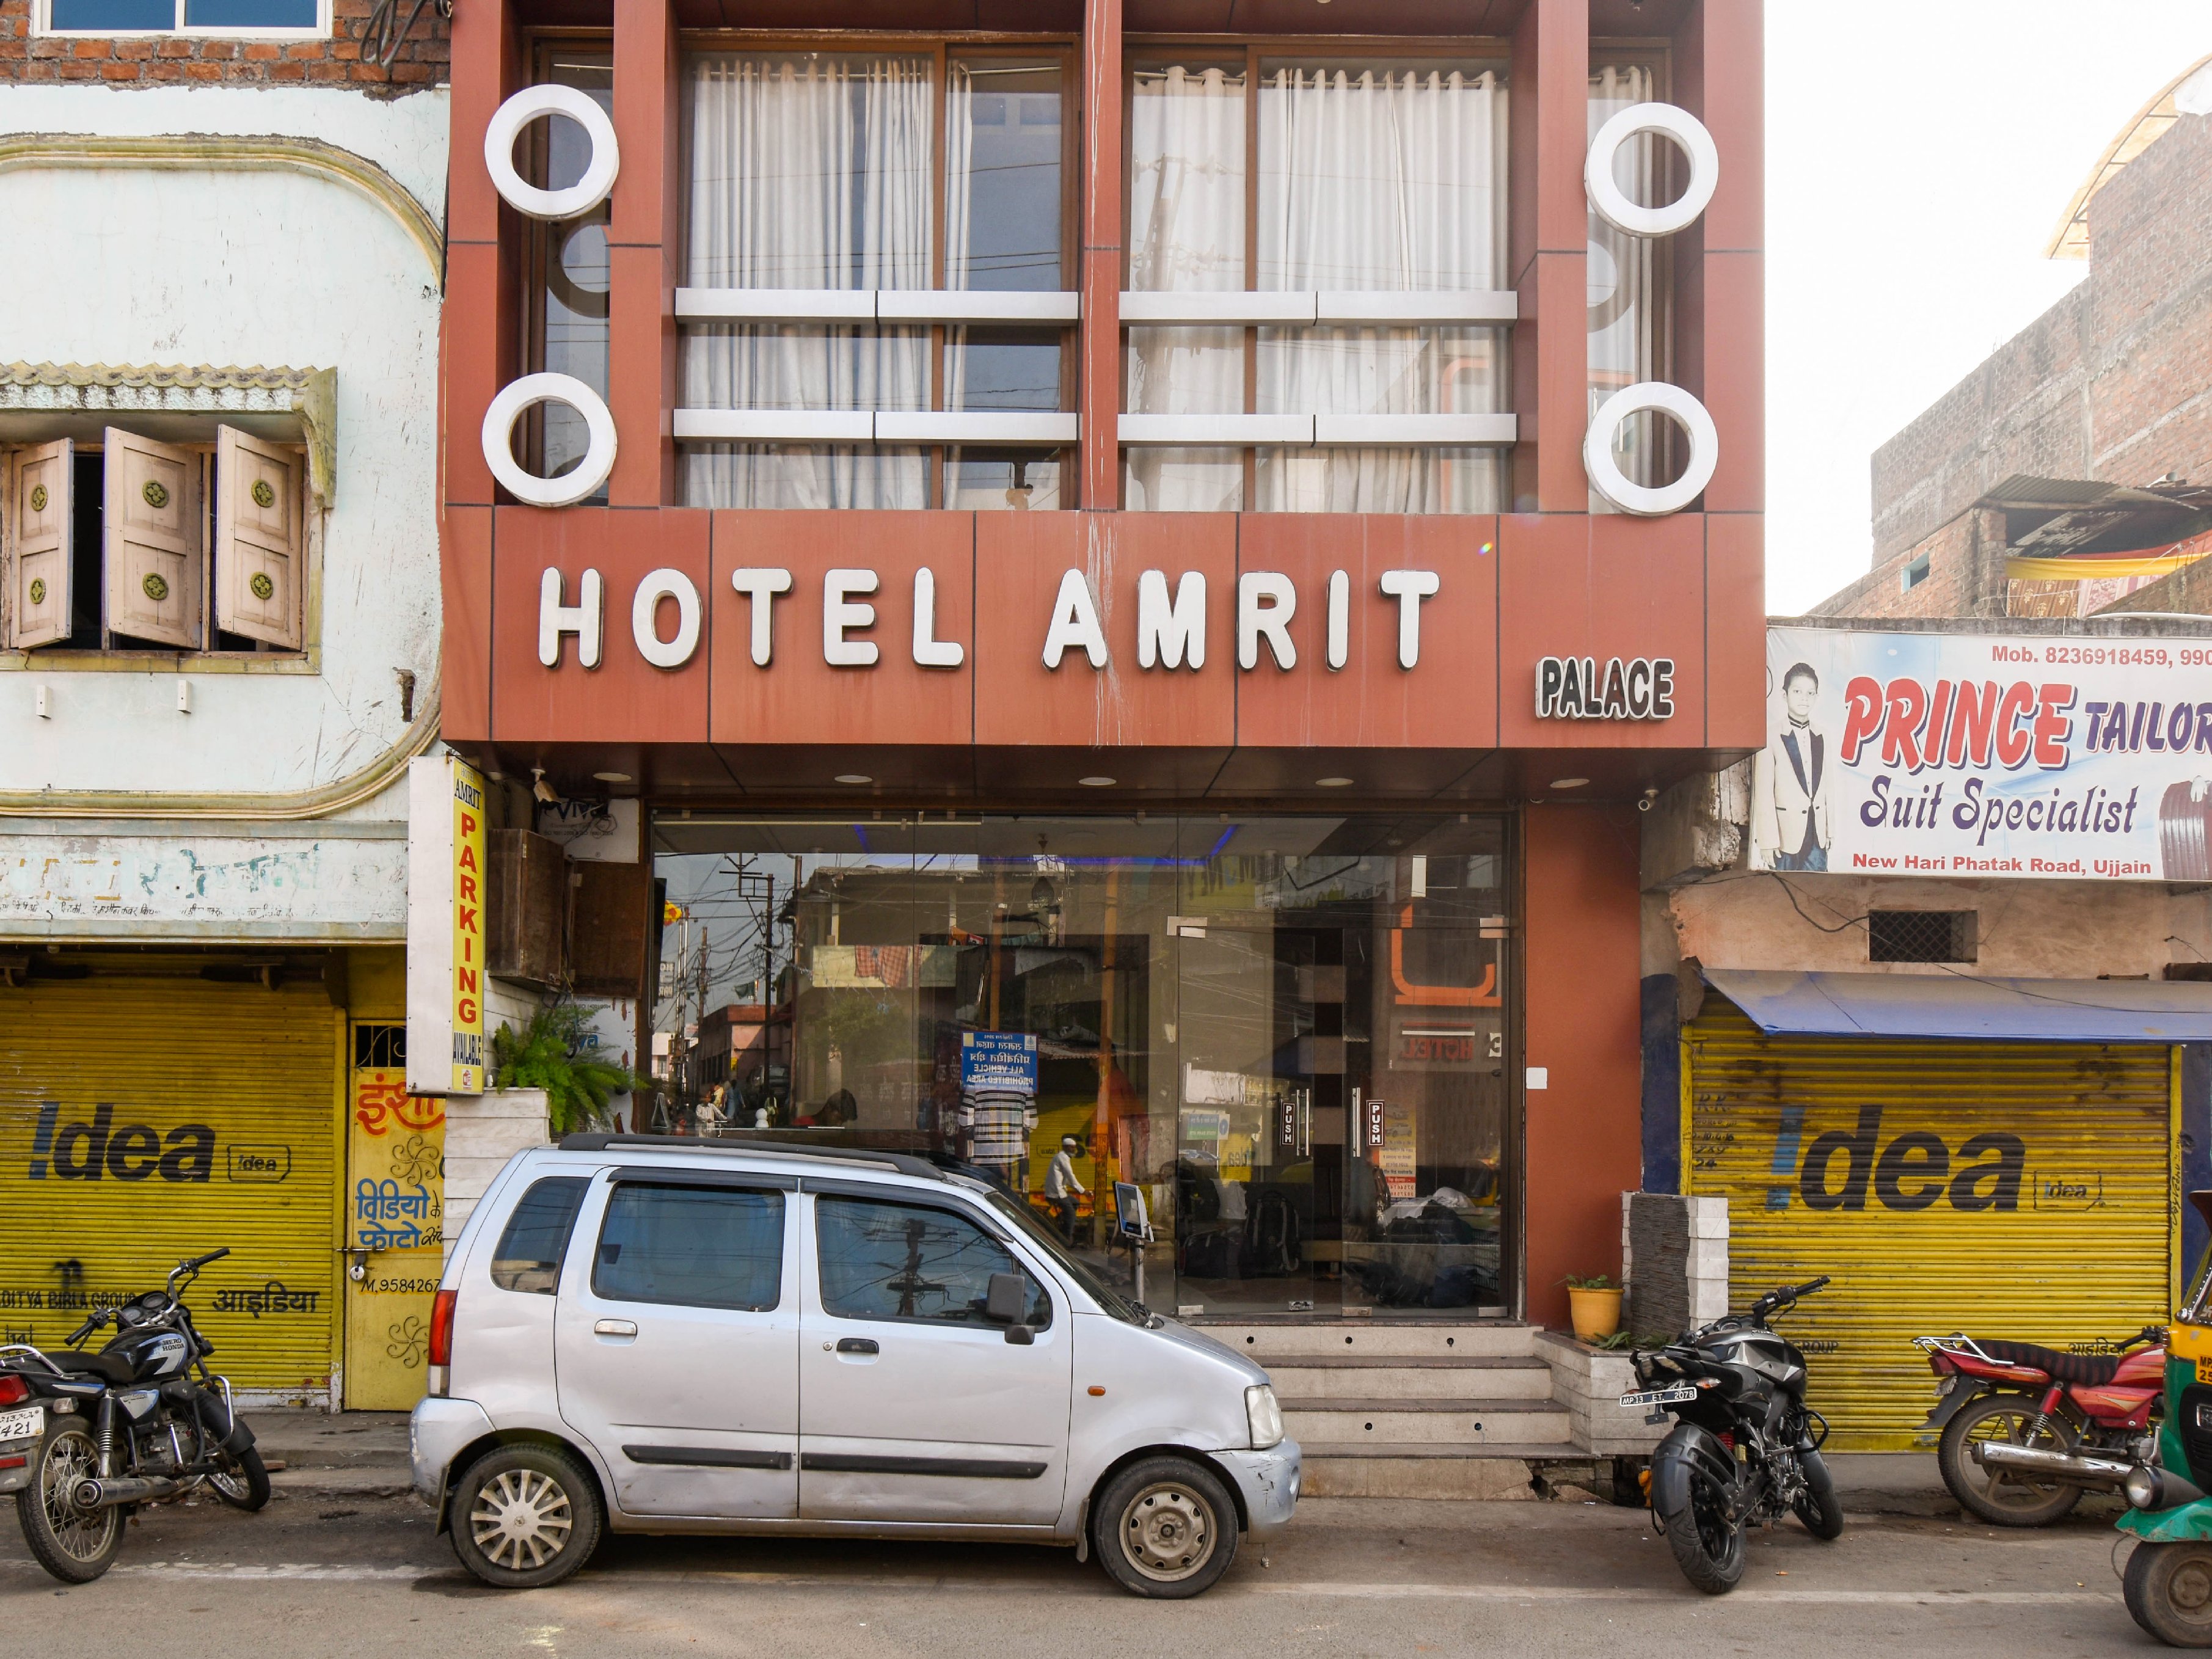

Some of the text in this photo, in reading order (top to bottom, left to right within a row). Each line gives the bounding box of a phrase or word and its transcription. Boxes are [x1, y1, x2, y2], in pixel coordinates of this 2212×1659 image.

[538, 566, 1441, 673] HOTEL AMRIT
[1992, 646, 2039, 662] Mob.
[2046, 647, 2173, 668] 8236918459,
[1535, 656, 1675, 721] PALACE
[1840, 676, 2212, 775] PRINCE TAILOR
[461, 767, 475, 783] HOTEL
[454, 778, 481, 810] AMRIT
[1860, 775, 2139, 847] Suit Specialist
[1853, 854, 2152, 878] New Hari Phatak Road, Ujjain
[458, 811, 478, 1024] PARKING
[453, 1032, 481, 1065] AVAILABLE
[1284, 1104, 1293, 1143] PUSH
[1371, 1104, 1381, 1143] PUSH
[355, 1178, 431, 1220] विडियो
[0, 1290, 43, 1309] DITYA
[48, 1291, 88, 1310] BIRLA
[212, 1282, 320, 1318] आइडिया
[162, 1343, 184, 1352] HONDA
[1674, 1390, 1694, 1399] 2078
